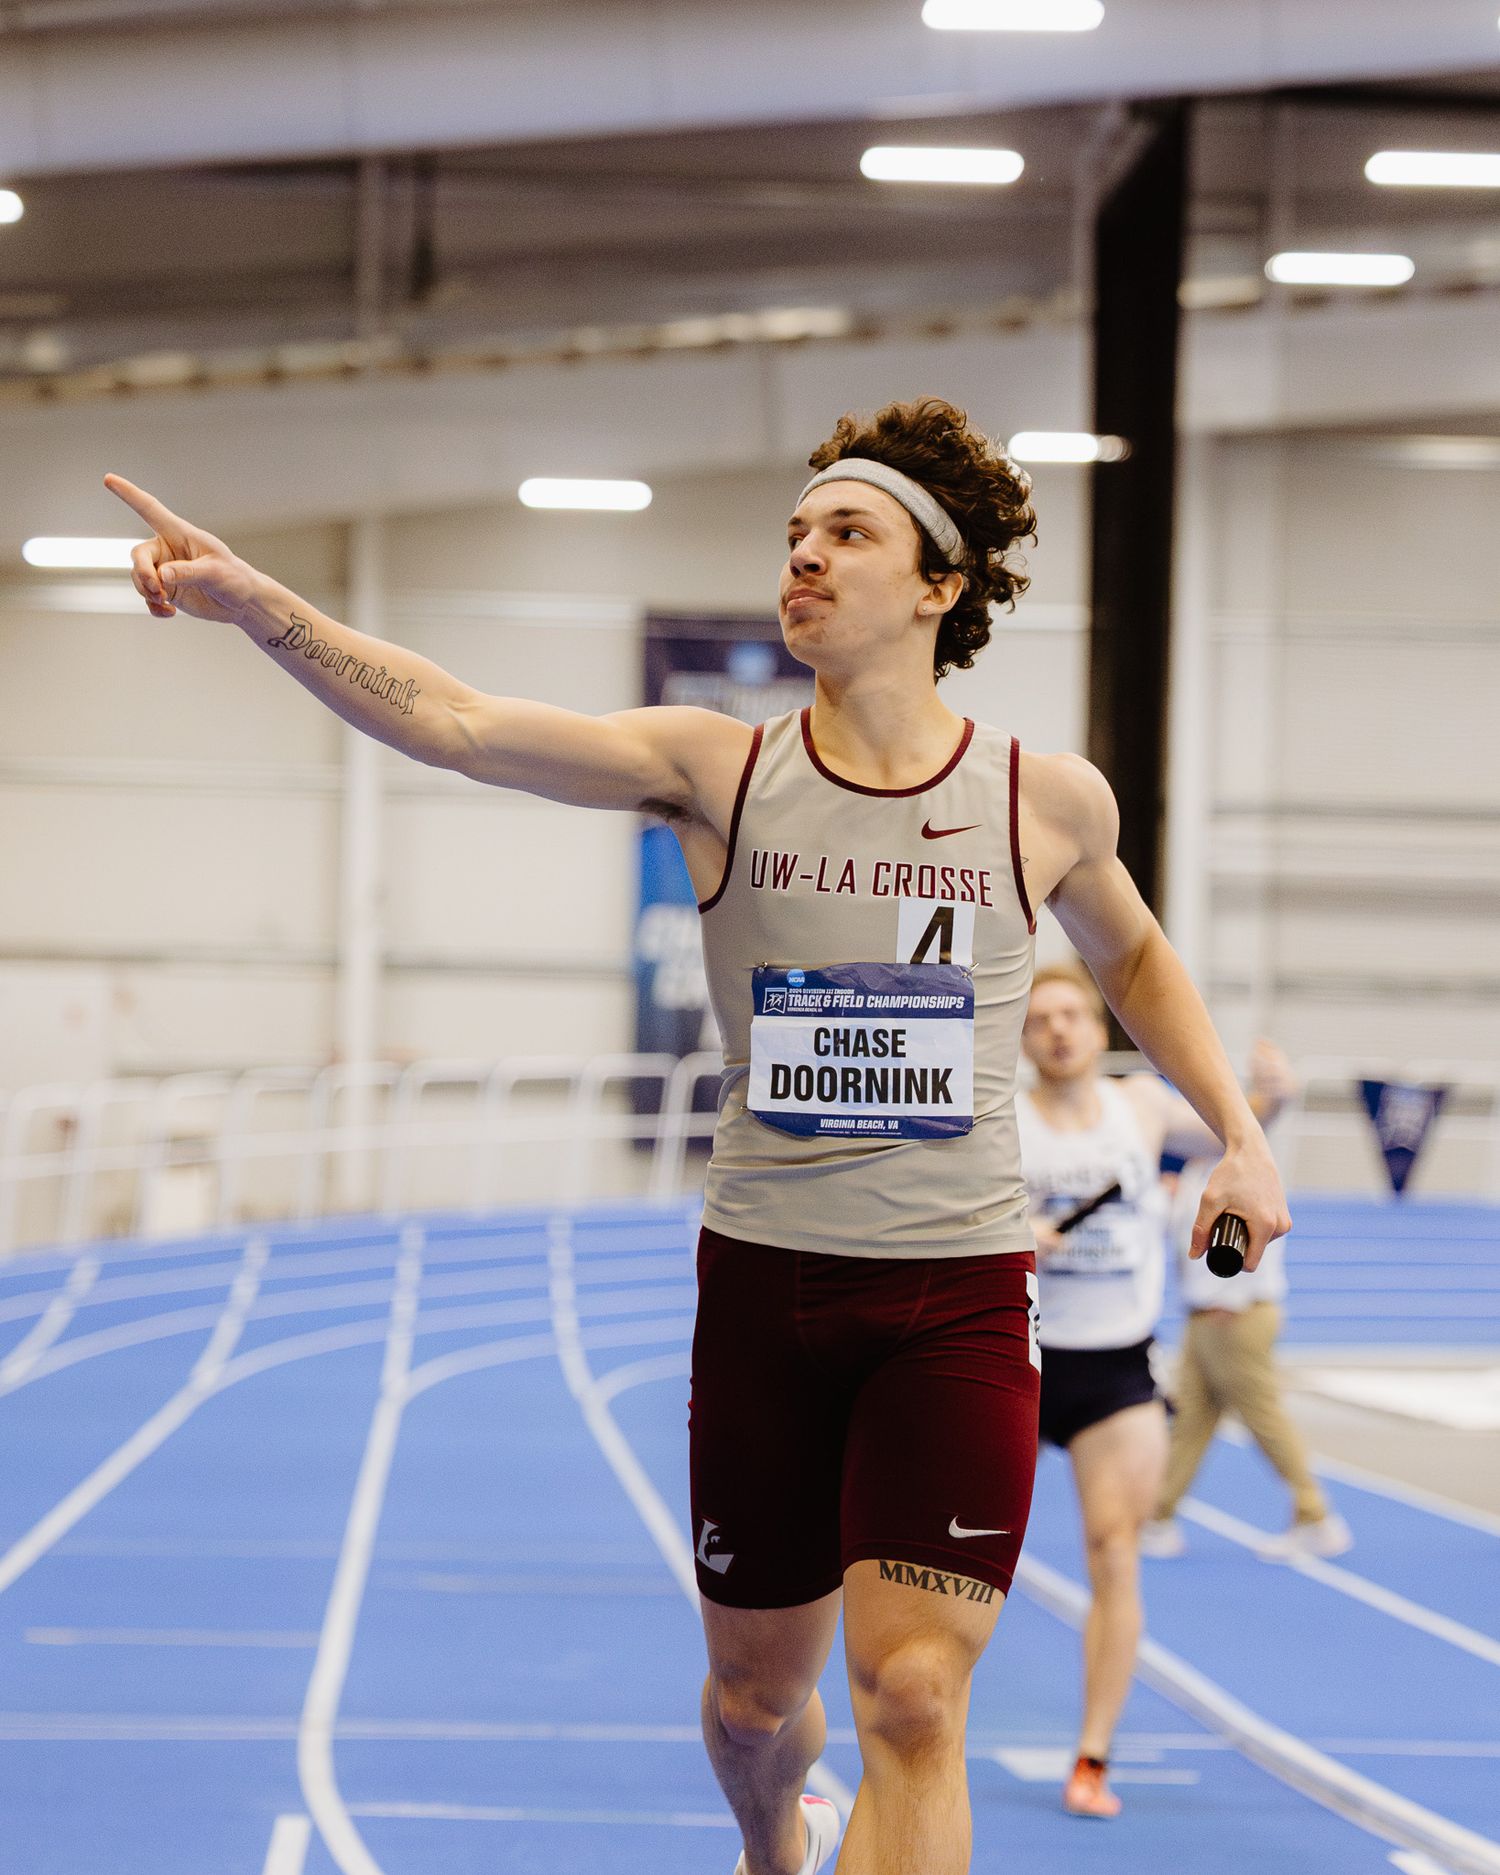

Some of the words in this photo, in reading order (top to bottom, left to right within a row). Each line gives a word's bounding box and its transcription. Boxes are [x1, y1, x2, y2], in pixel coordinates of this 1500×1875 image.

[267, 612, 421, 715] Doornink
[750, 849, 857, 895] UW-LA
[871, 860, 994, 908] CROSSE
[788, 994, 823, 1007] TRACK
[823, 995, 832, 1007] &
[832, 995, 865, 1008] FIELD
[866, 995, 966, 1009] CHAMPIONSHIPS
[813, 1027, 907, 1058] CHASE
[770, 1063, 953, 1104] DOORNINK
[820, 1118, 855, 1129] VIRGINIA
[856, 1119, 886, 1130] BEACH,
[887, 1120, 899, 1130] VA
[879, 1560, 996, 1604] MMXVIII
